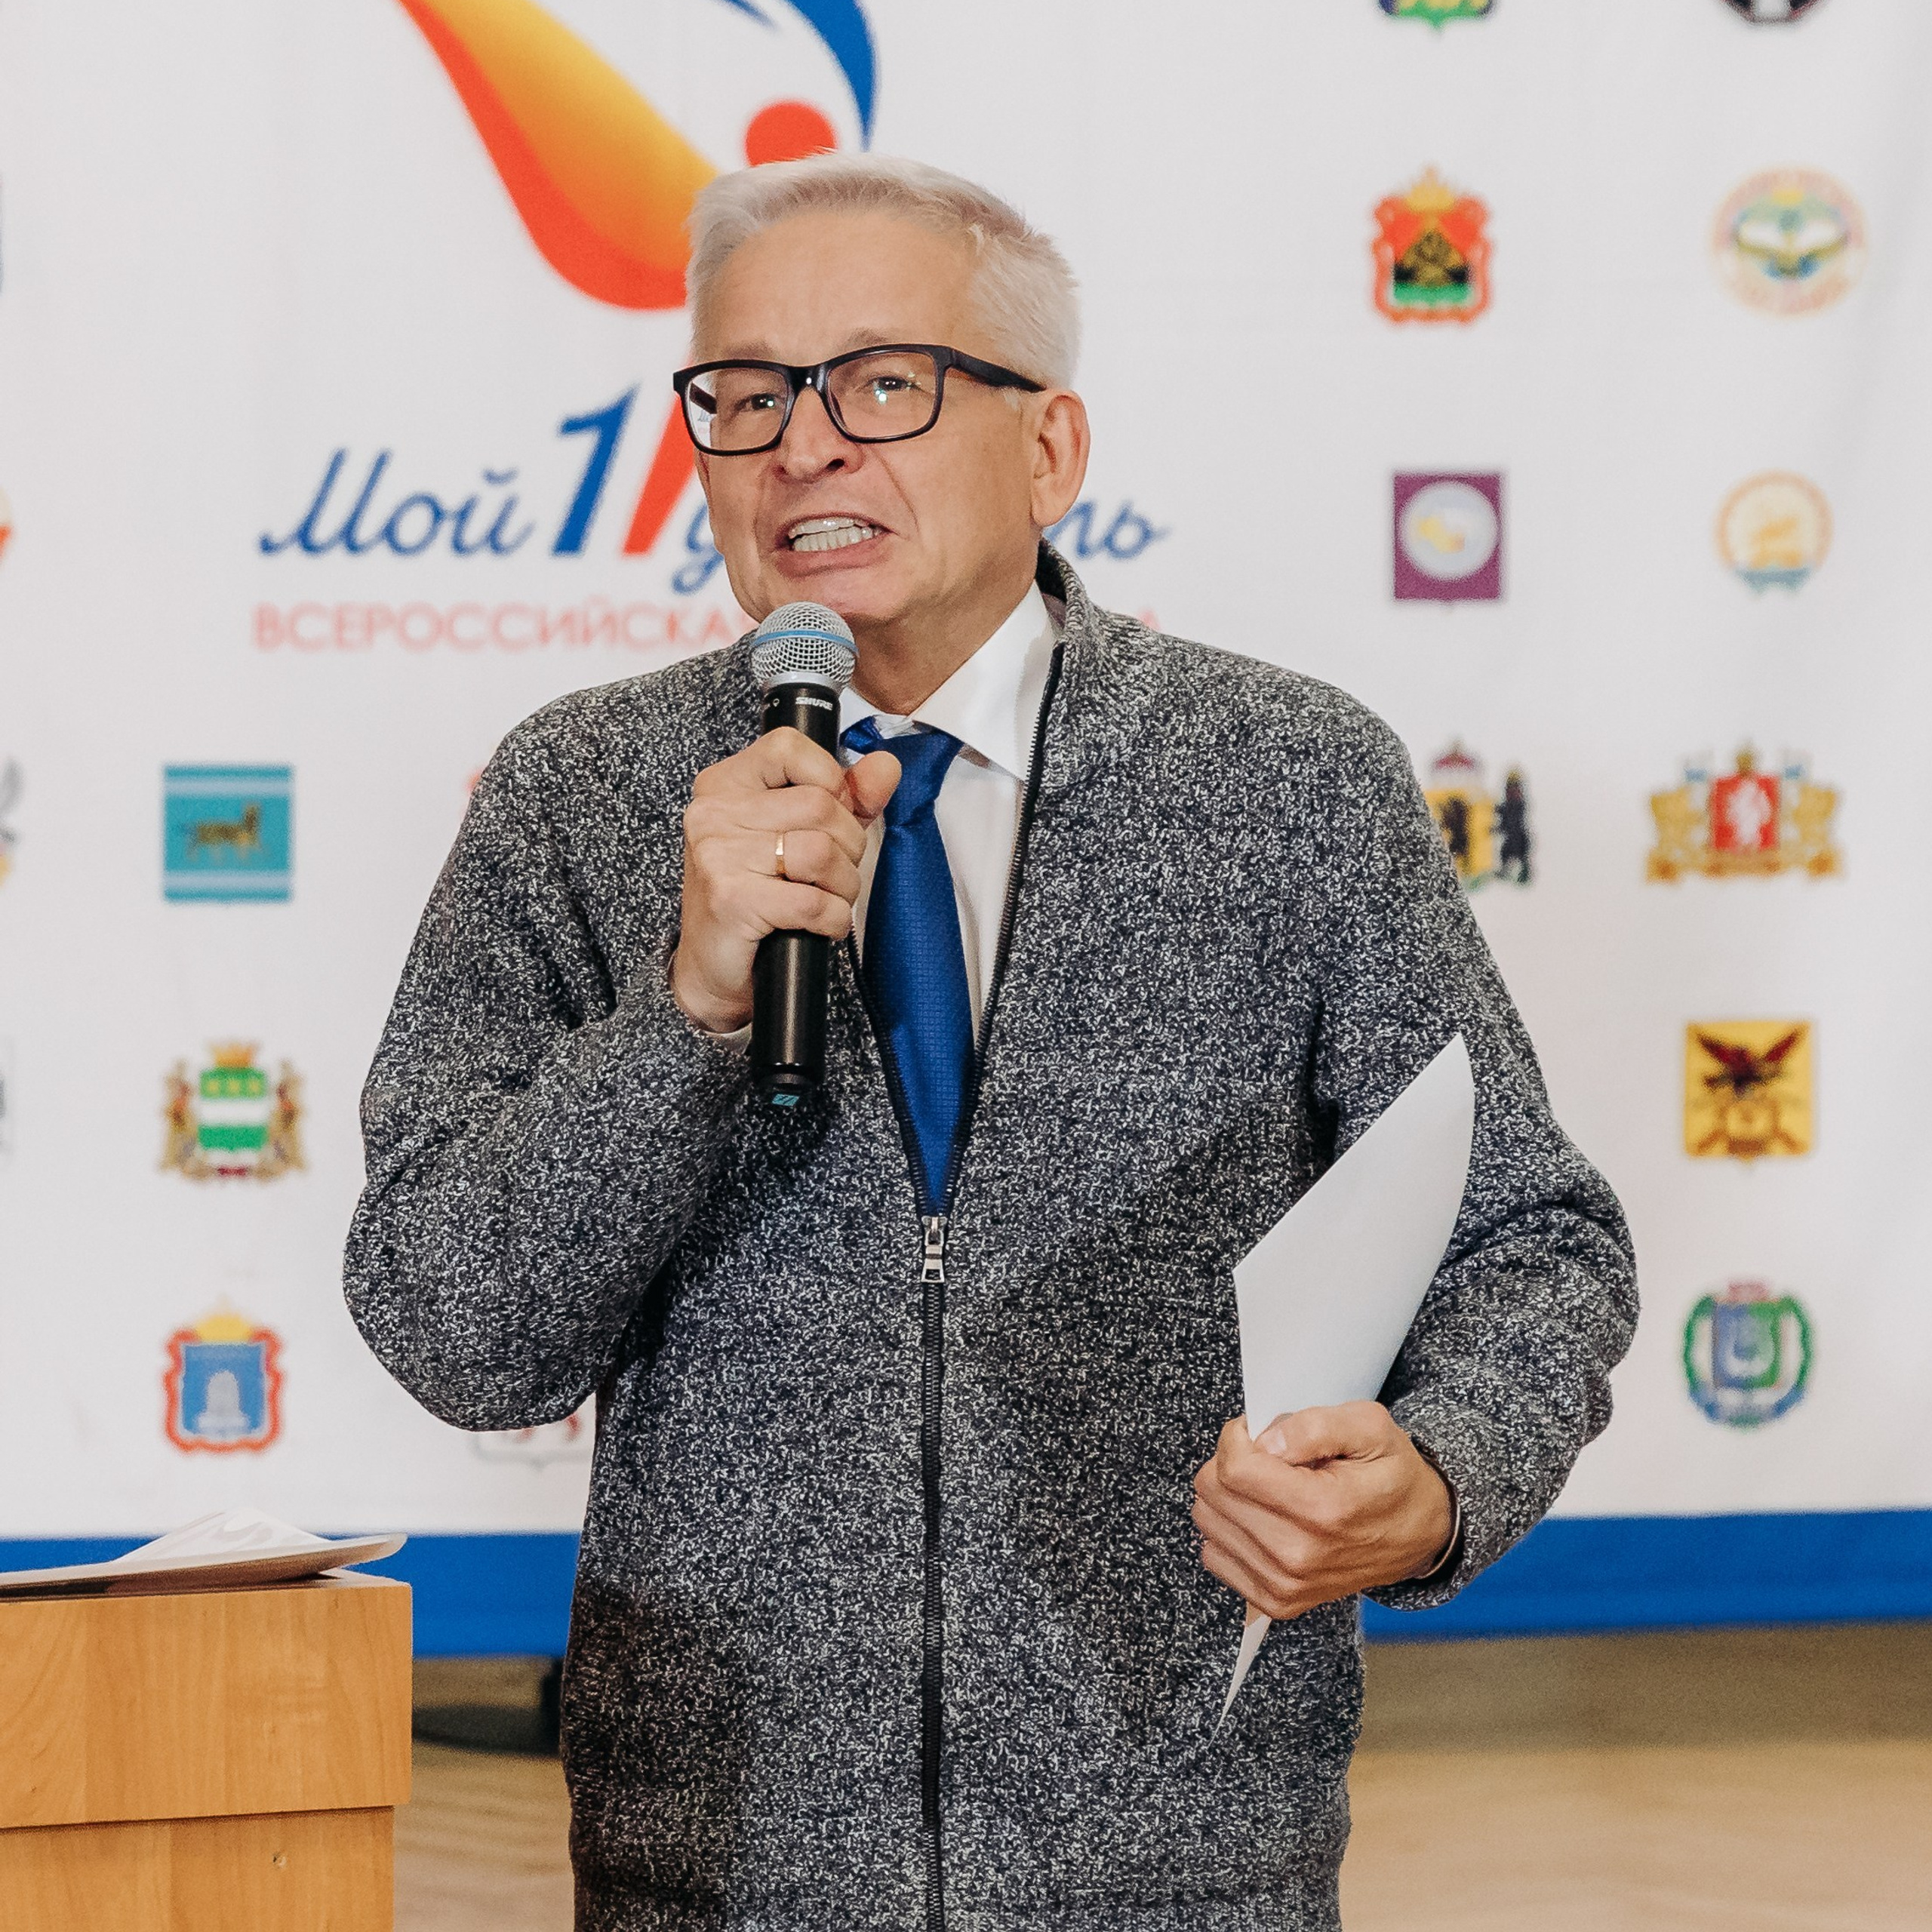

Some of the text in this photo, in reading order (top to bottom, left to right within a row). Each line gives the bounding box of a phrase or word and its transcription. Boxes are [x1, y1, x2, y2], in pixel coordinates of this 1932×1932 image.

[258, 447, 534, 557] Мой
[252, 595, 757, 651] ВСЕРОССИЙСКА
[795, 696, 833, 711] SHURE
